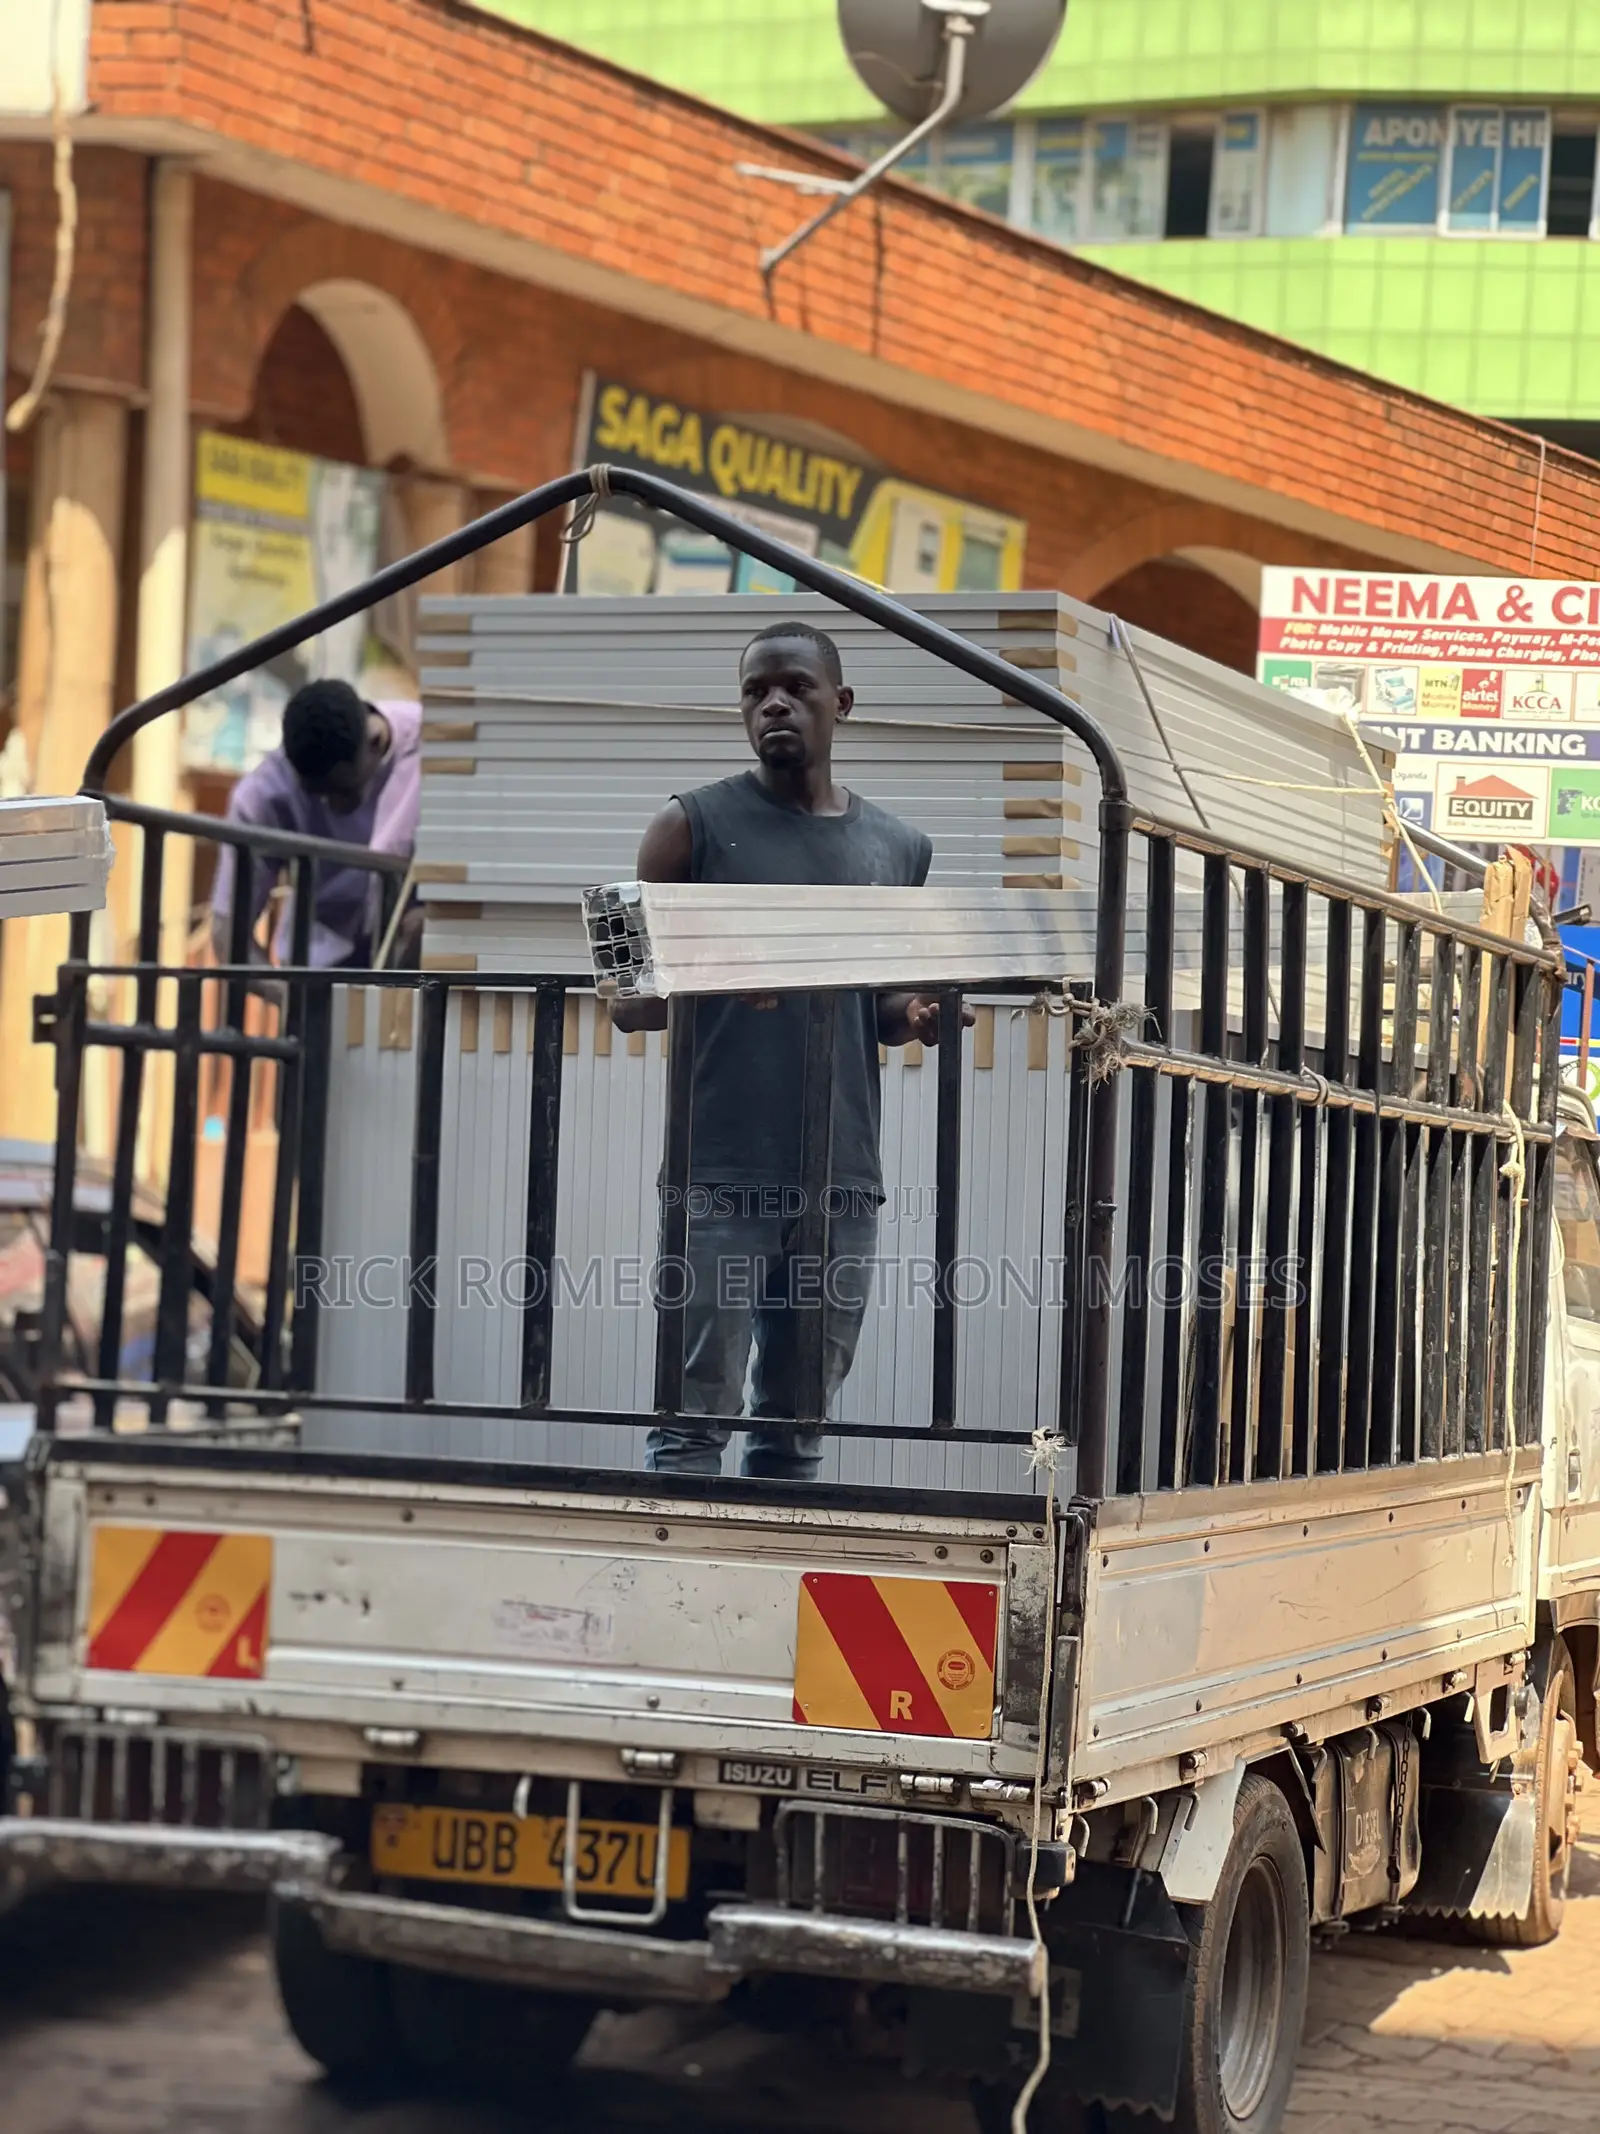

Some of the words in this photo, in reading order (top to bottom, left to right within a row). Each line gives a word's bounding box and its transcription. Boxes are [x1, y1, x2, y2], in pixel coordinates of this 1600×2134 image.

[596, 384, 704, 475] SAGA
[709, 425, 864, 518] QUALITY
[1291, 576, 1480, 622] NEEMA
[1496, 584, 1534, 624] &
[1318, 623, 1369, 638] Mobile
[1369, 625, 1418, 641] Money
[1421, 628, 1488, 645] Services,
[1280, 636, 1324, 650] Photo
[1326, 639, 1363, 654] Copy
[1366, 641, 1379, 653] &
[1447, 644, 1495, 658] Phone
[1424, 678, 1448, 688] MTN
[1462, 688, 1499, 702] airtel
[1512, 695, 1562, 709] KCCA
[1432, 728, 1586, 757] BANKING
[1451, 800, 1530, 818] EQUITY
[889, 1690, 913, 1721] R
[723, 1762, 792, 1785] ISUZU
[806, 1769, 889, 1794] ELF
[432, 1816, 518, 1875] UBB
